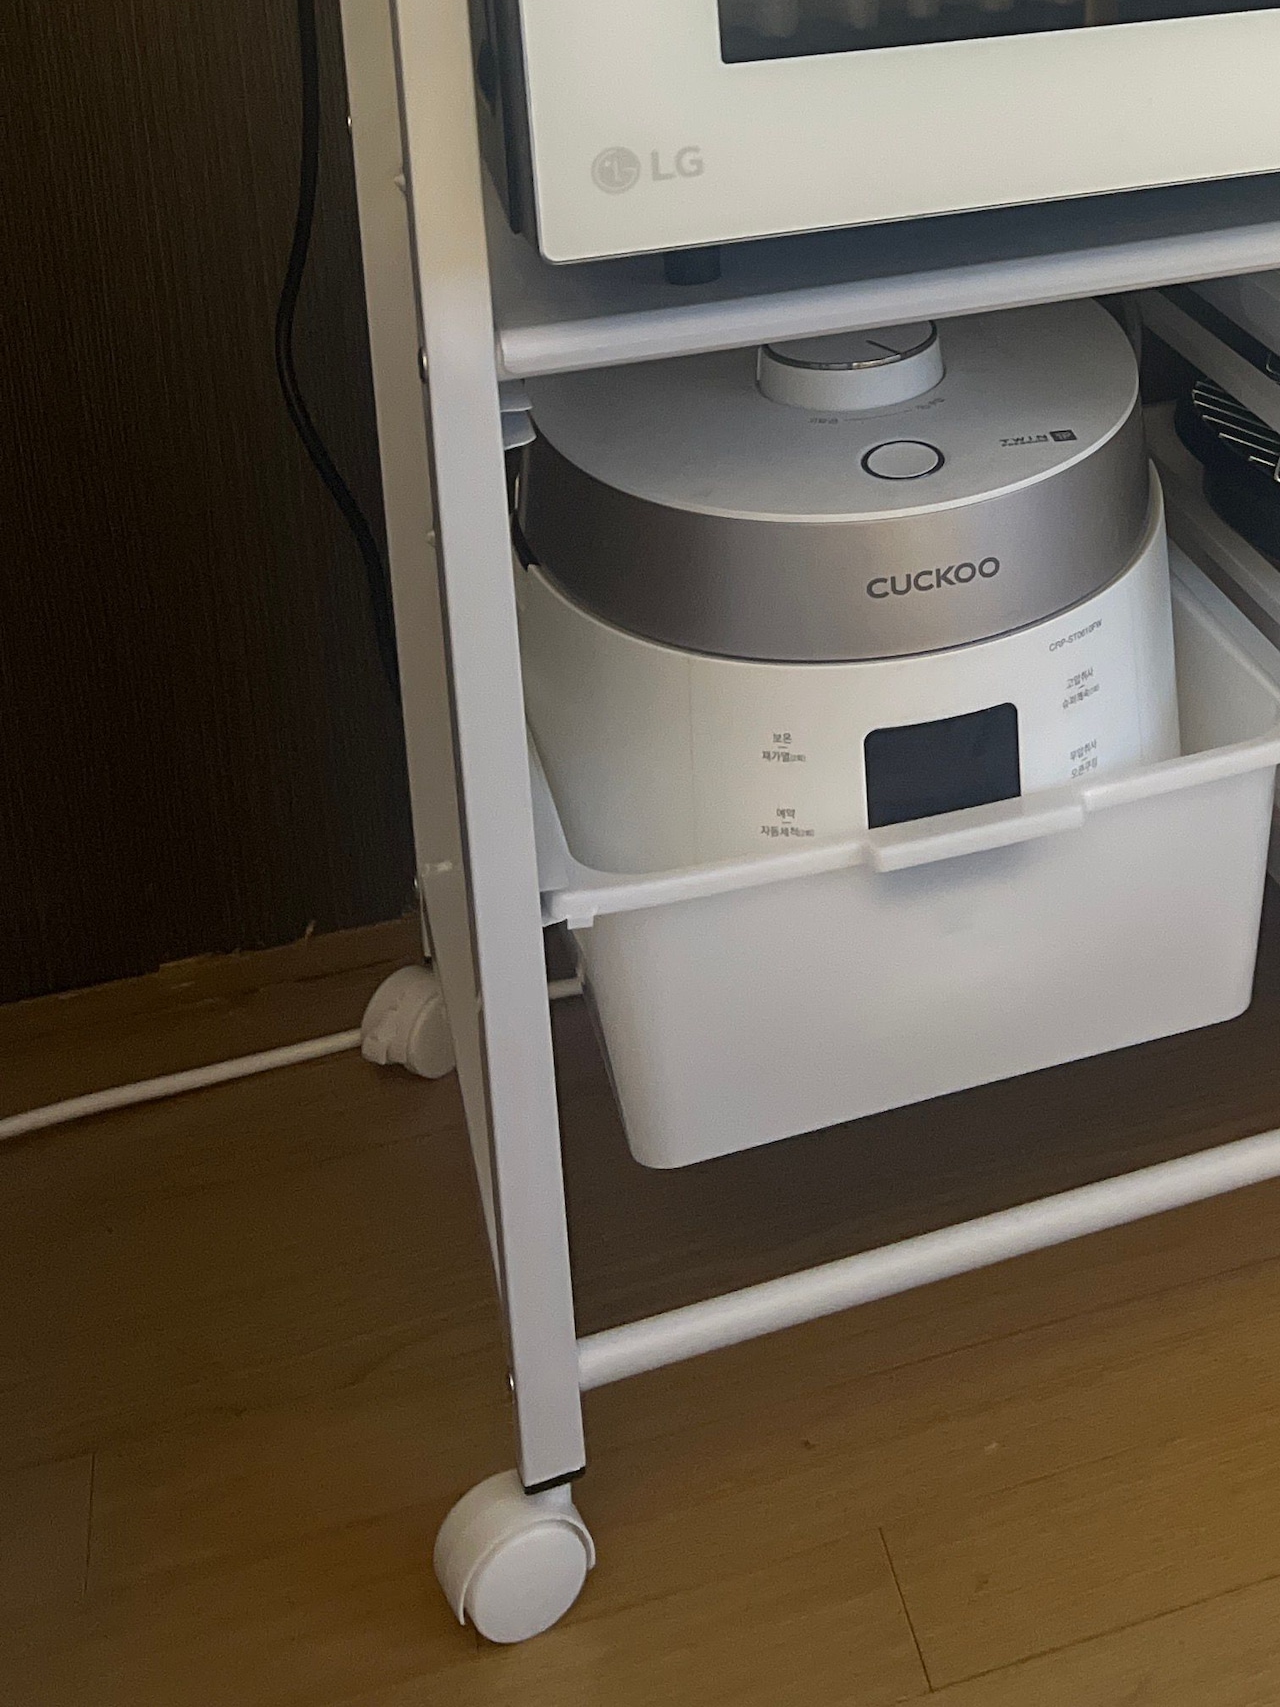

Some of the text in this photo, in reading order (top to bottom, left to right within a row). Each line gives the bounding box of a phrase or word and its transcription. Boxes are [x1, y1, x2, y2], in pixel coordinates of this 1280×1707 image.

[650, 146, 705, 181] LG
[866, 556, 1001, 599] CUCKOO
[772, 733, 792, 744] 보온
[776, 808, 796, 819] 예약
